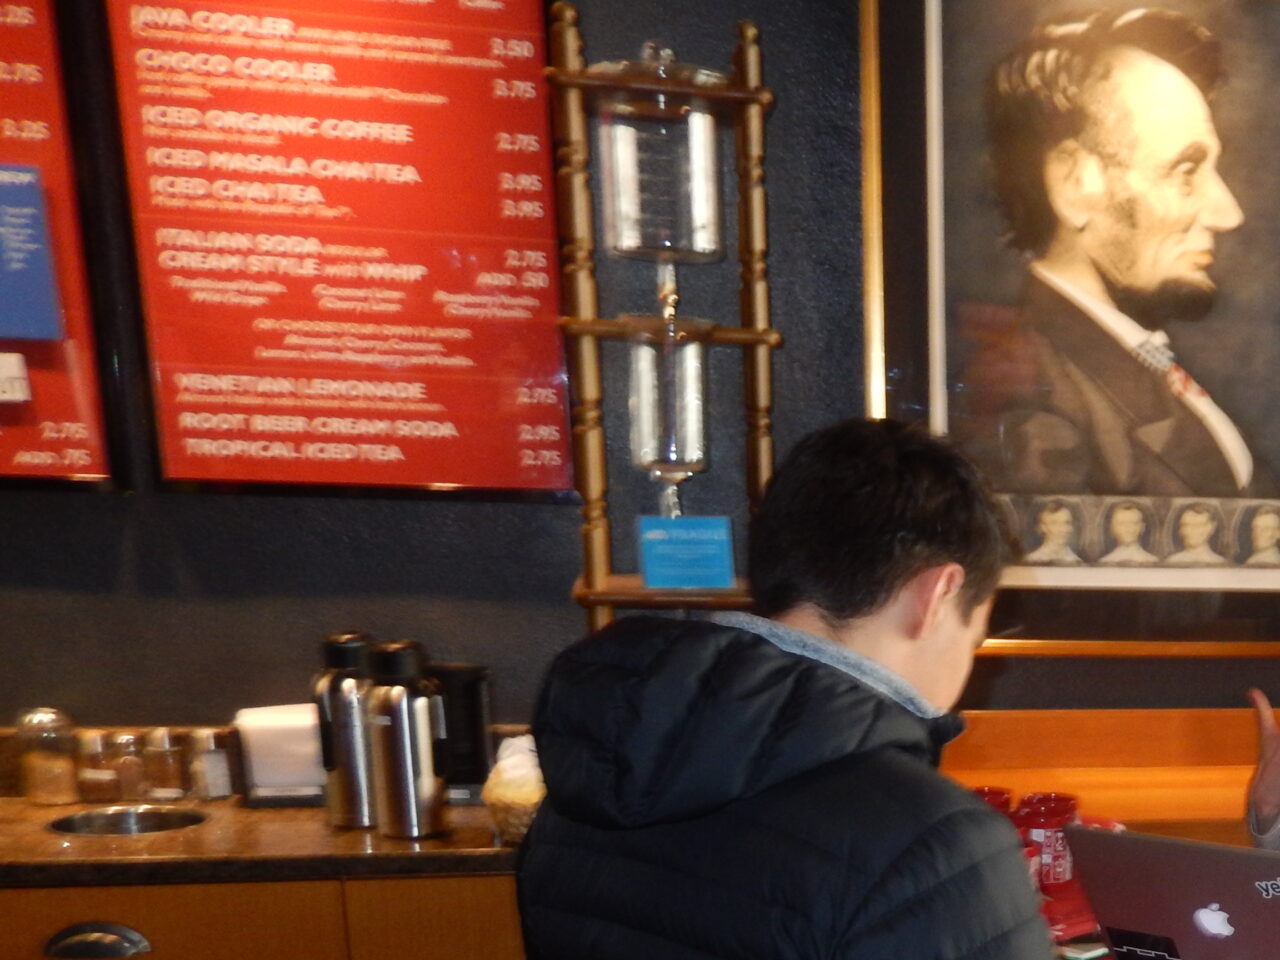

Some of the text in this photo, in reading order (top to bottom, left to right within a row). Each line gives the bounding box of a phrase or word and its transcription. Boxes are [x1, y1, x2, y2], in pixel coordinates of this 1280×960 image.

[191, 10, 297, 39] COOLER
[135, 48, 233, 76] CHOCO
[234, 56, 338, 82] COOLER
[142, 104, 203, 128] ICED
[203, 109, 320, 137] ORGANIC
[320, 118, 414, 142] COFFEE
[147, 146, 208, 169] ICED
[209, 151, 311, 177] MASALA
[374, 162, 422, 184] TEA
[150, 175, 212, 197] ICED
[275, 182, 325, 204] TEA
[155, 228, 255, 251] ITALIAN
[255, 233, 322, 254] SODA
[297, 378, 428, 399] LEMONADE
[393, 420, 459, 438] SODA
